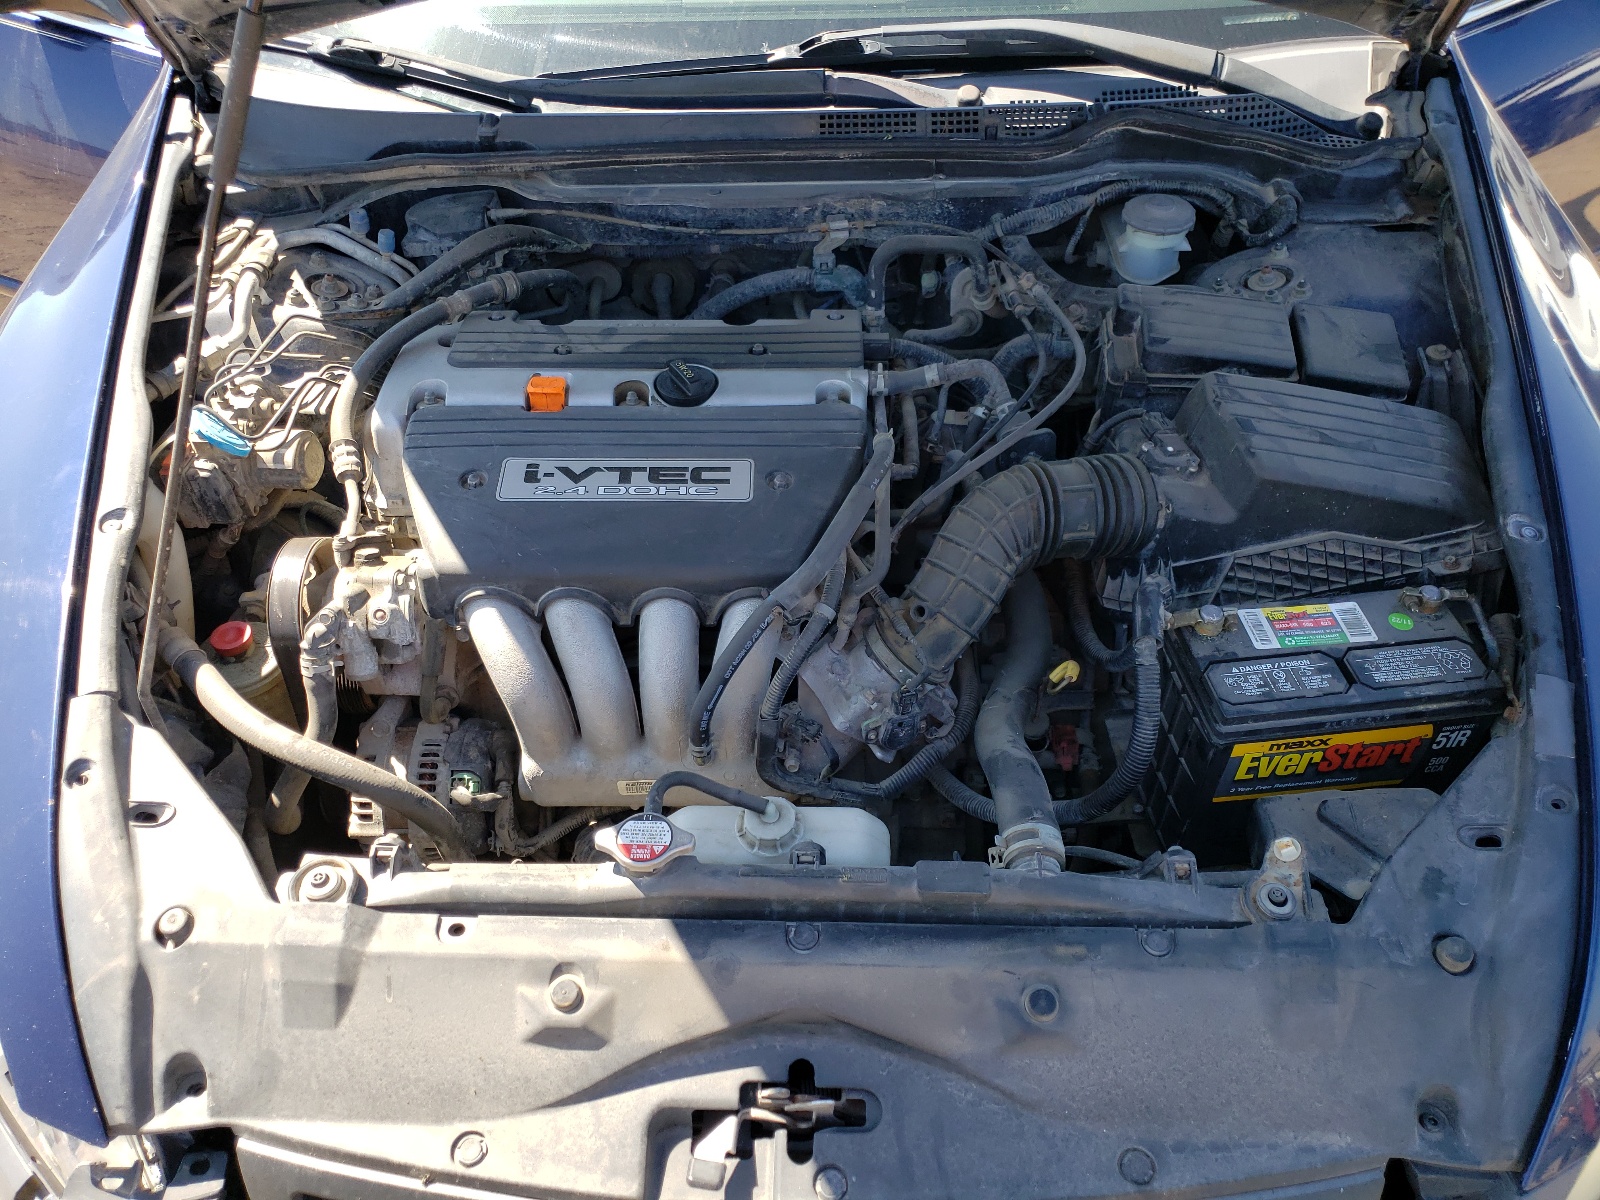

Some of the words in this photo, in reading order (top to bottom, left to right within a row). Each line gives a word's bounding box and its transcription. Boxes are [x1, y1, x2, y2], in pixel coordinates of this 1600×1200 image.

[675, 362, 694, 378] 5W-20
[523, 463, 731, 485] i-VTEC
[533, 485, 589, 496] 2.4
[597, 485, 719, 496] DOHC
[1240, 663, 1273, 673] DANGER
[1280, 659, 1311, 668] POISON
[1268, 737, 1333, 752] maxx
[1432, 729, 1472, 750] 51R
[1234, 736, 1423, 781] EverStart
[1429, 756, 1450, 766] 500
[1424, 764, 1444, 773] CCA
